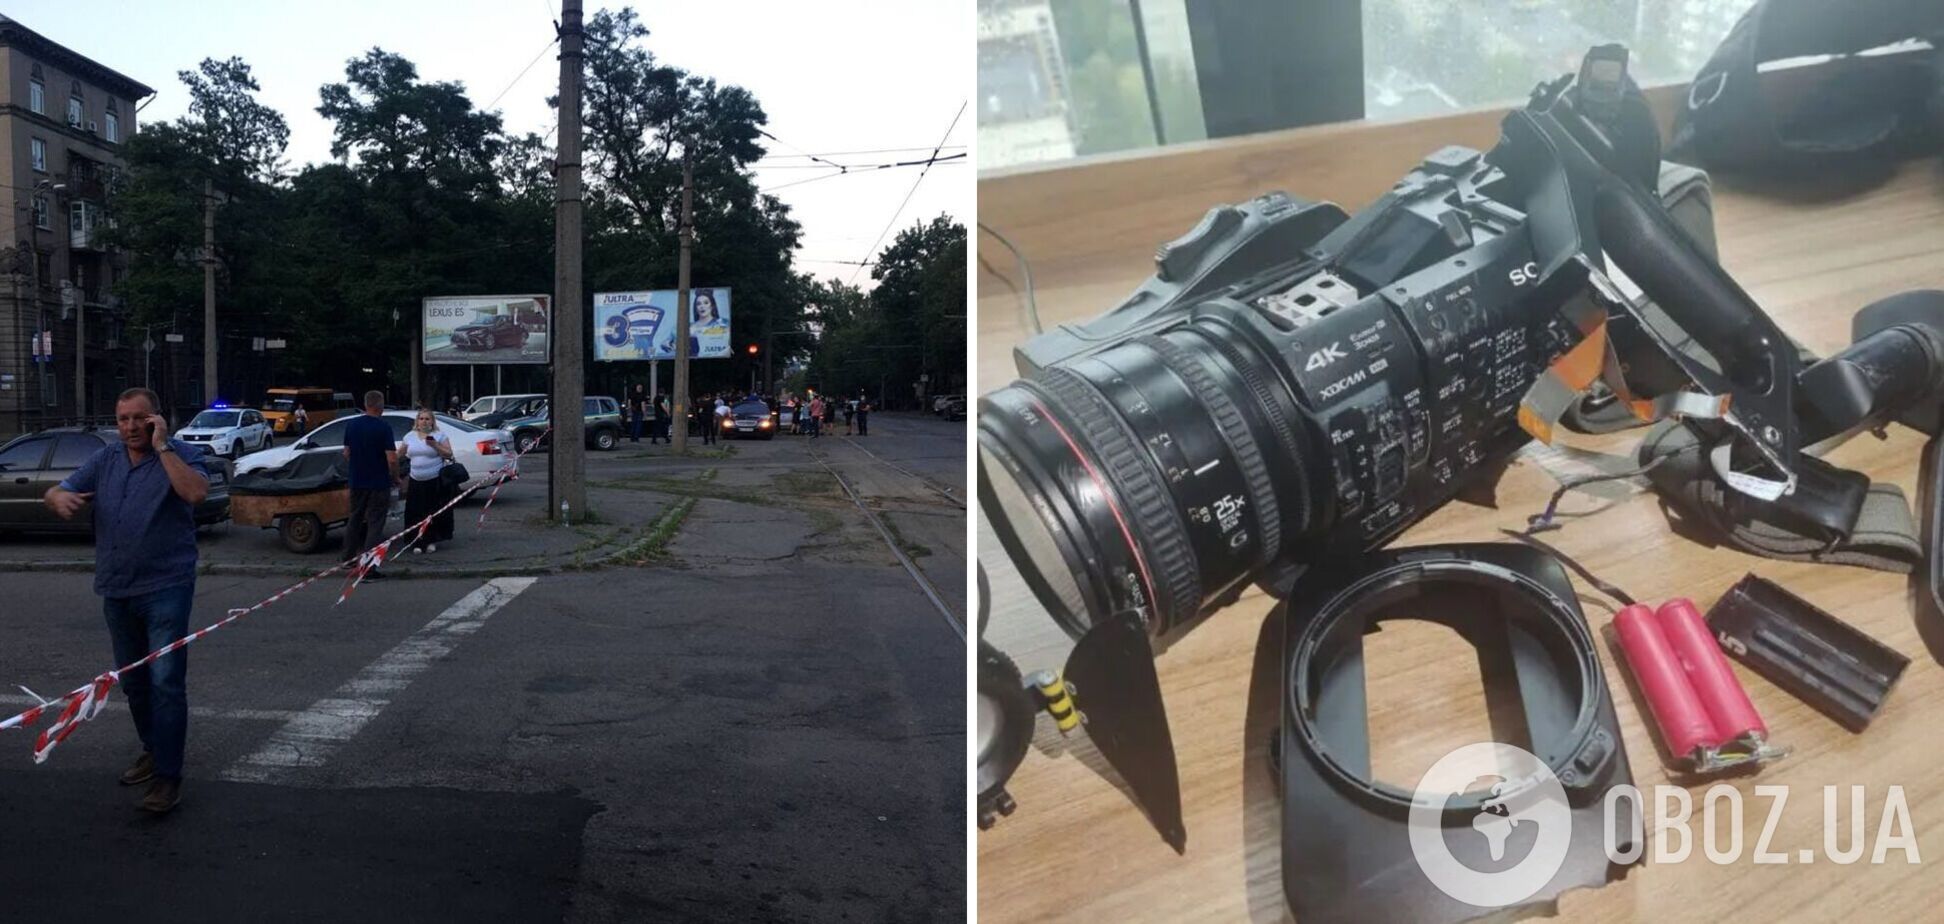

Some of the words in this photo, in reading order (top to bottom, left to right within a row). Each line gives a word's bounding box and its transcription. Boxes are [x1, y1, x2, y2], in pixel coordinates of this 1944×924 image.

[429, 306, 453, 318] LEXUS
[454, 306, 465, 318] ES
[604, 315, 629, 347] 3
[1304, 341, 1349, 372] 4K
[1319, 369, 1367, 401] XDCAM
[1213, 494, 1246, 519] 25x
